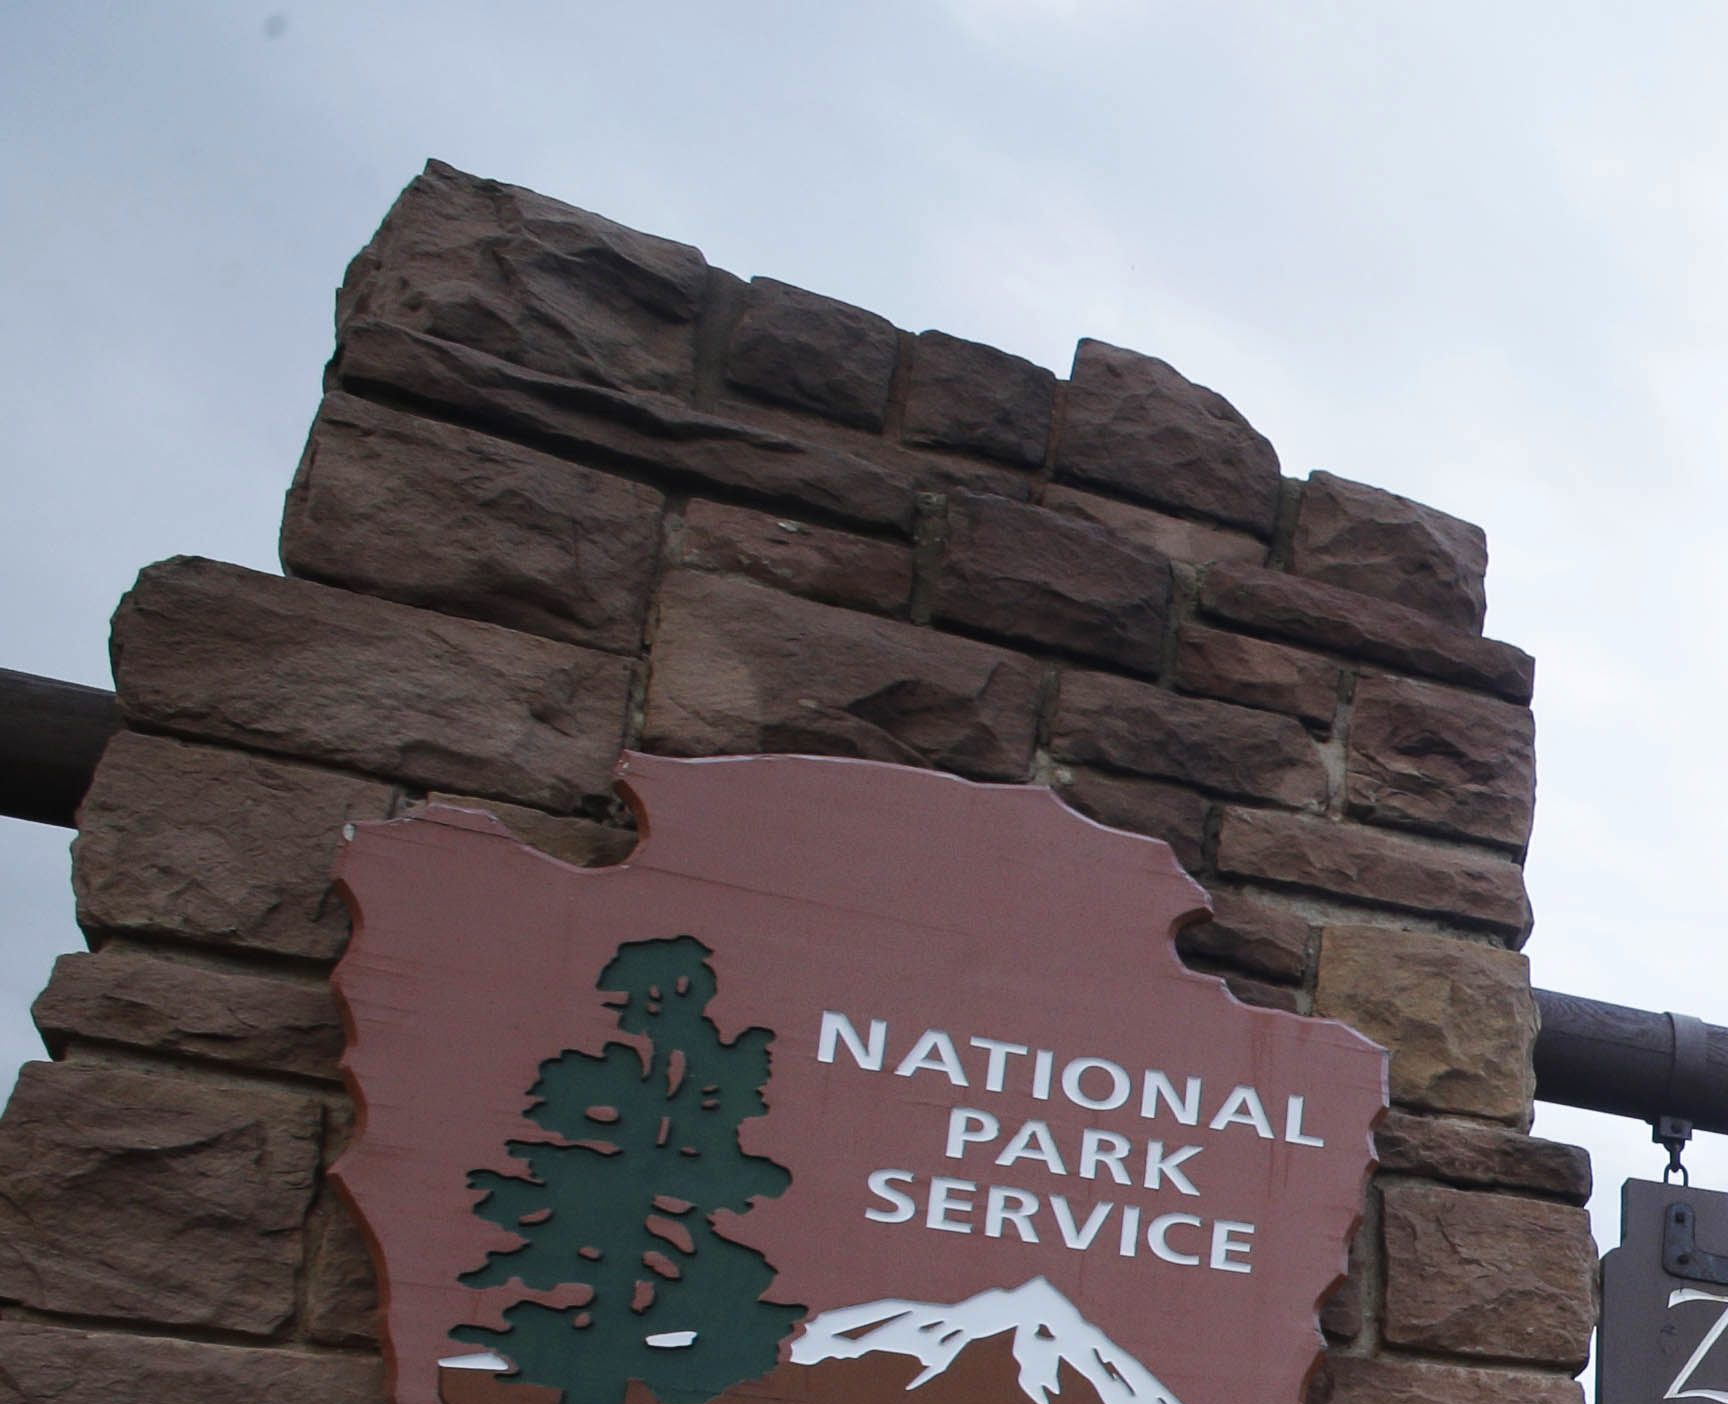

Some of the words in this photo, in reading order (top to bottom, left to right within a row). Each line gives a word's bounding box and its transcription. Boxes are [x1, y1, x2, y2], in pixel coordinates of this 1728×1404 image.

[817, 1010, 1325, 1148] NATIONAL
[945, 1107, 1203, 1196] PARK
[865, 1169, 1256, 1274] SERVICE
